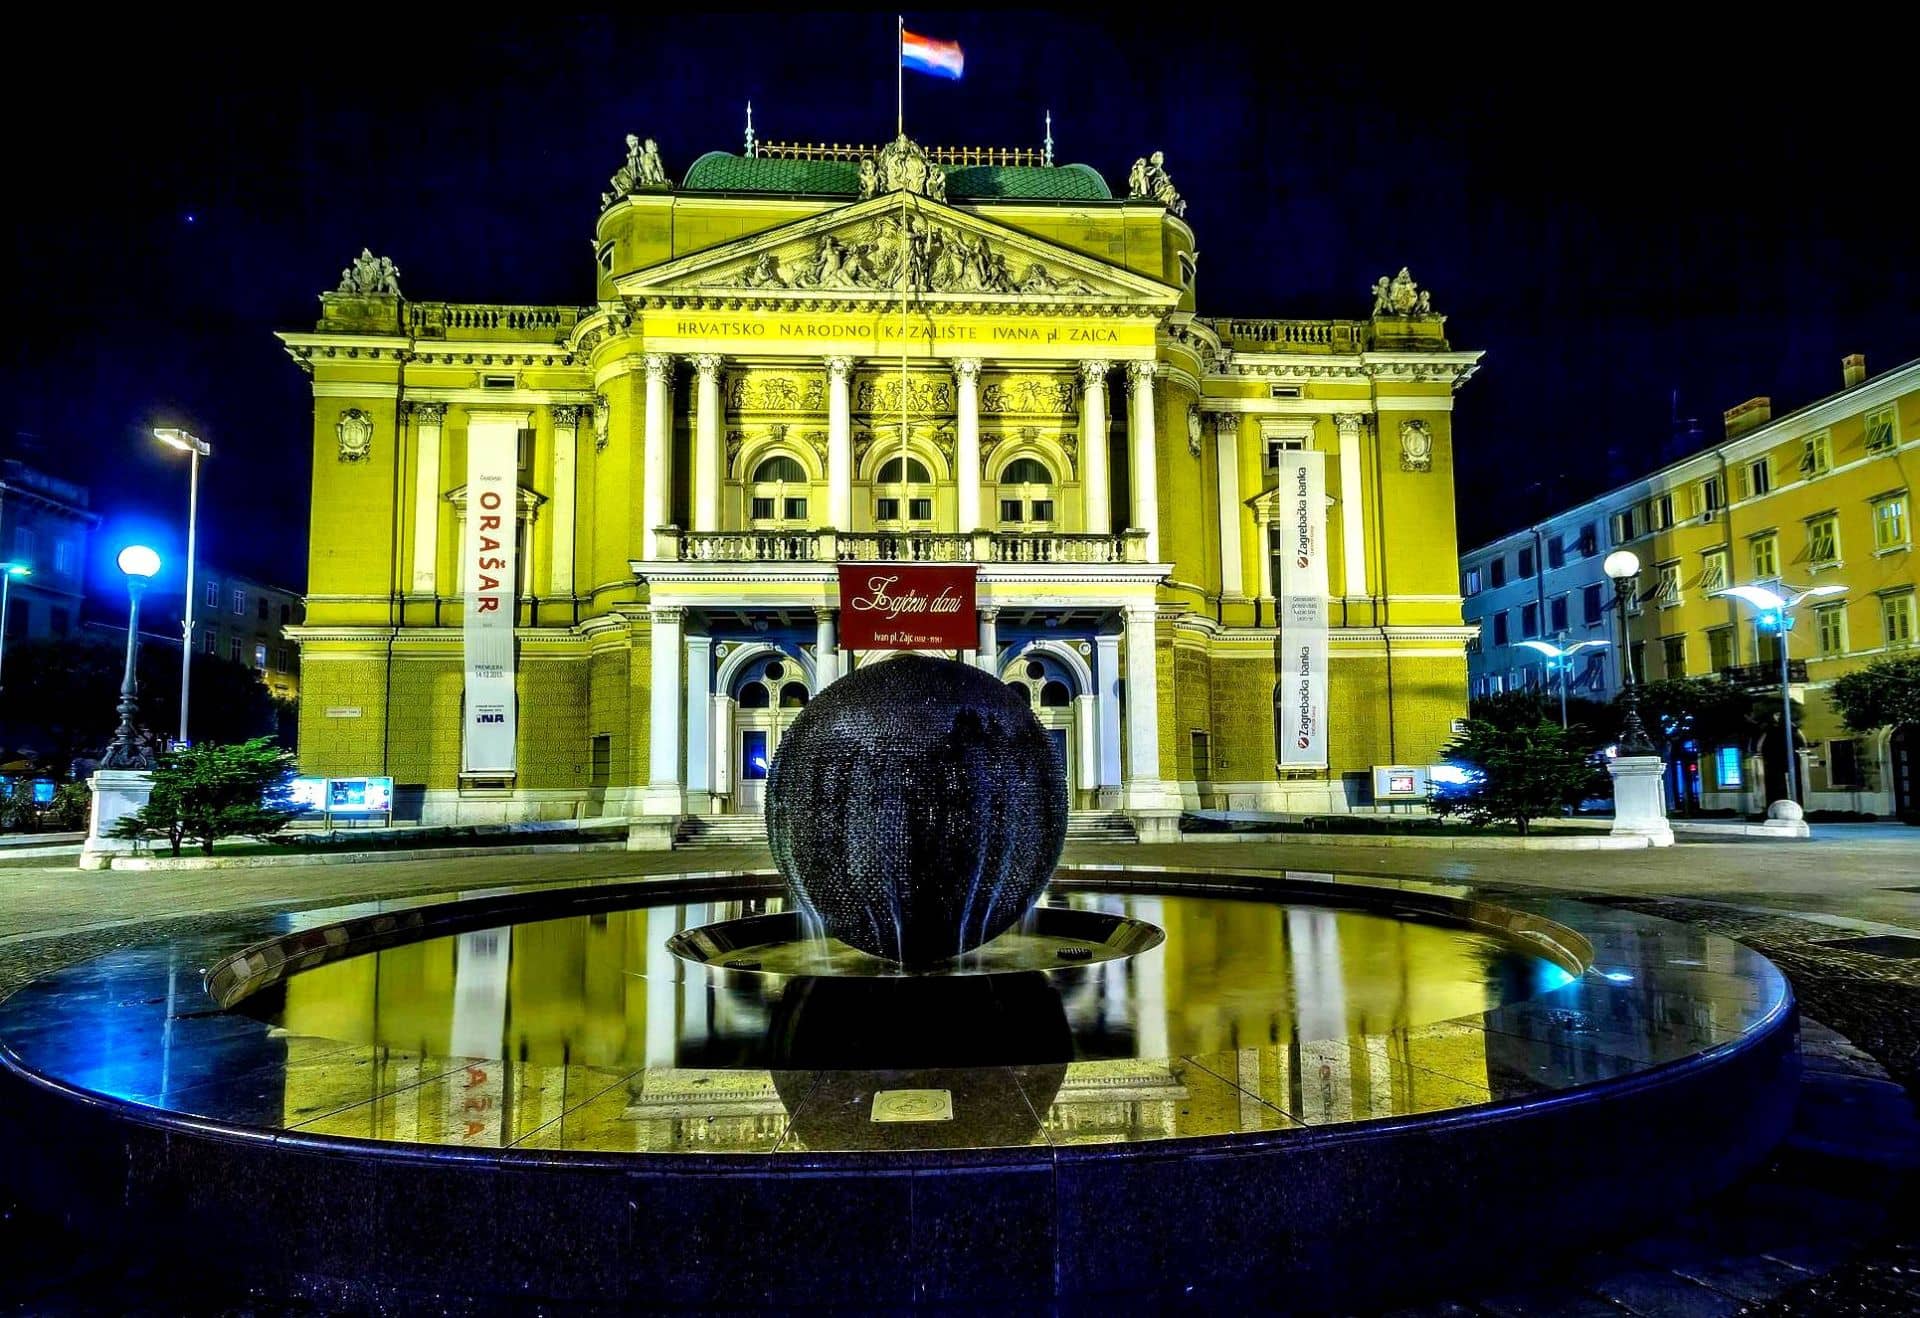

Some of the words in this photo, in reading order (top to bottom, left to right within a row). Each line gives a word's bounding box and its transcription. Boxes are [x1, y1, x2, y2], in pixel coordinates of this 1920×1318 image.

[677, 322, 765, 336] HRVATSKO
[780, 324, 871, 337] NARODNO
[993, 327, 1040, 340] IVANA
[1297, 467, 1307, 497] banka
[477, 491, 506, 613] ORAŠAR
[930, 586, 963, 613] dani
[874, 631, 889, 642] Ivan
[899, 631, 914, 646] Zajc
[1299, 646, 1310, 677] banka
